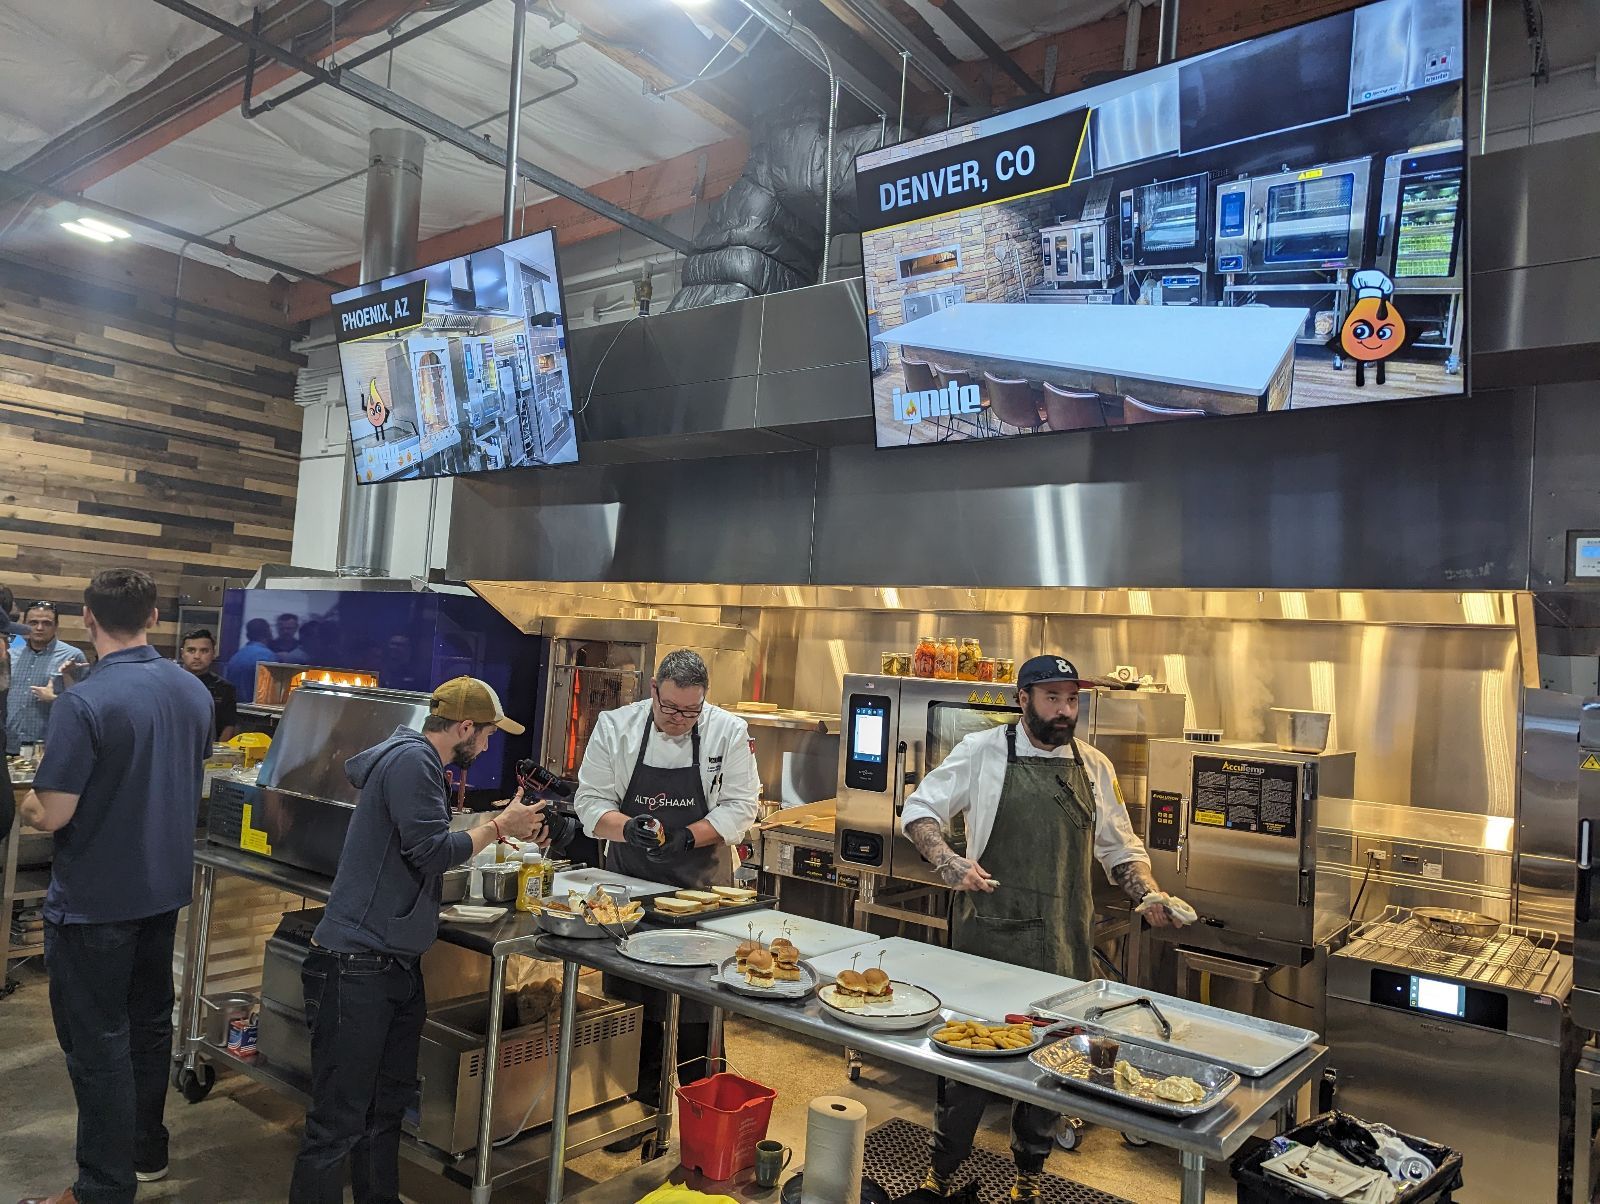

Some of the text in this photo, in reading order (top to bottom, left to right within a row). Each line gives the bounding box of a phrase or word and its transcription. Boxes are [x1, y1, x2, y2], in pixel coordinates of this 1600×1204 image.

[879, 145, 1035, 212] DENVER, CO
[341, 297, 410, 331] PHOENIX, AZ
[892, 380, 981, 424] ignite
[1222, 760, 1265, 775] AccuTemp
